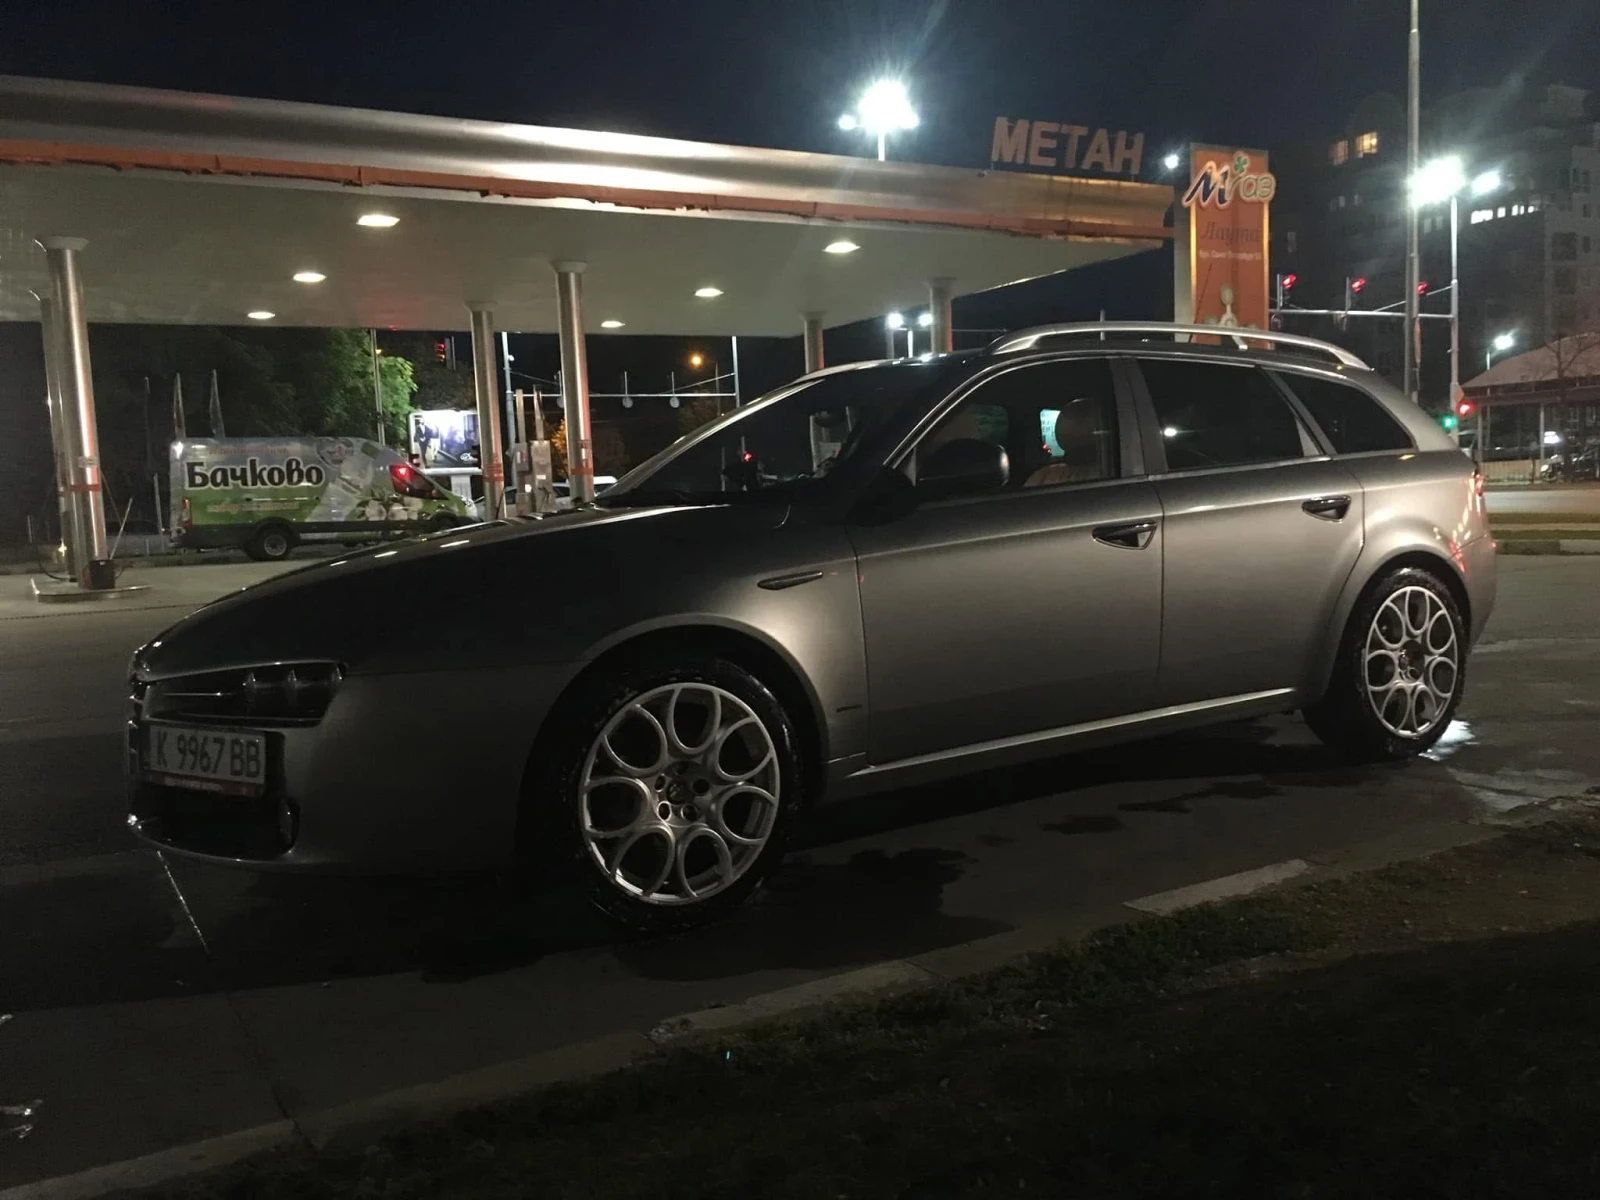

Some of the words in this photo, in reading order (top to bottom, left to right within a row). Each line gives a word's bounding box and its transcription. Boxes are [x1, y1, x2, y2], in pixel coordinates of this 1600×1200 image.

[991, 116, 1145, 175] МЕТАН
[185, 457, 324, 489] Бачково
[156, 729, 168, 768] K
[177, 733, 226, 774] 9967
[230, 737, 261, 779] BB
